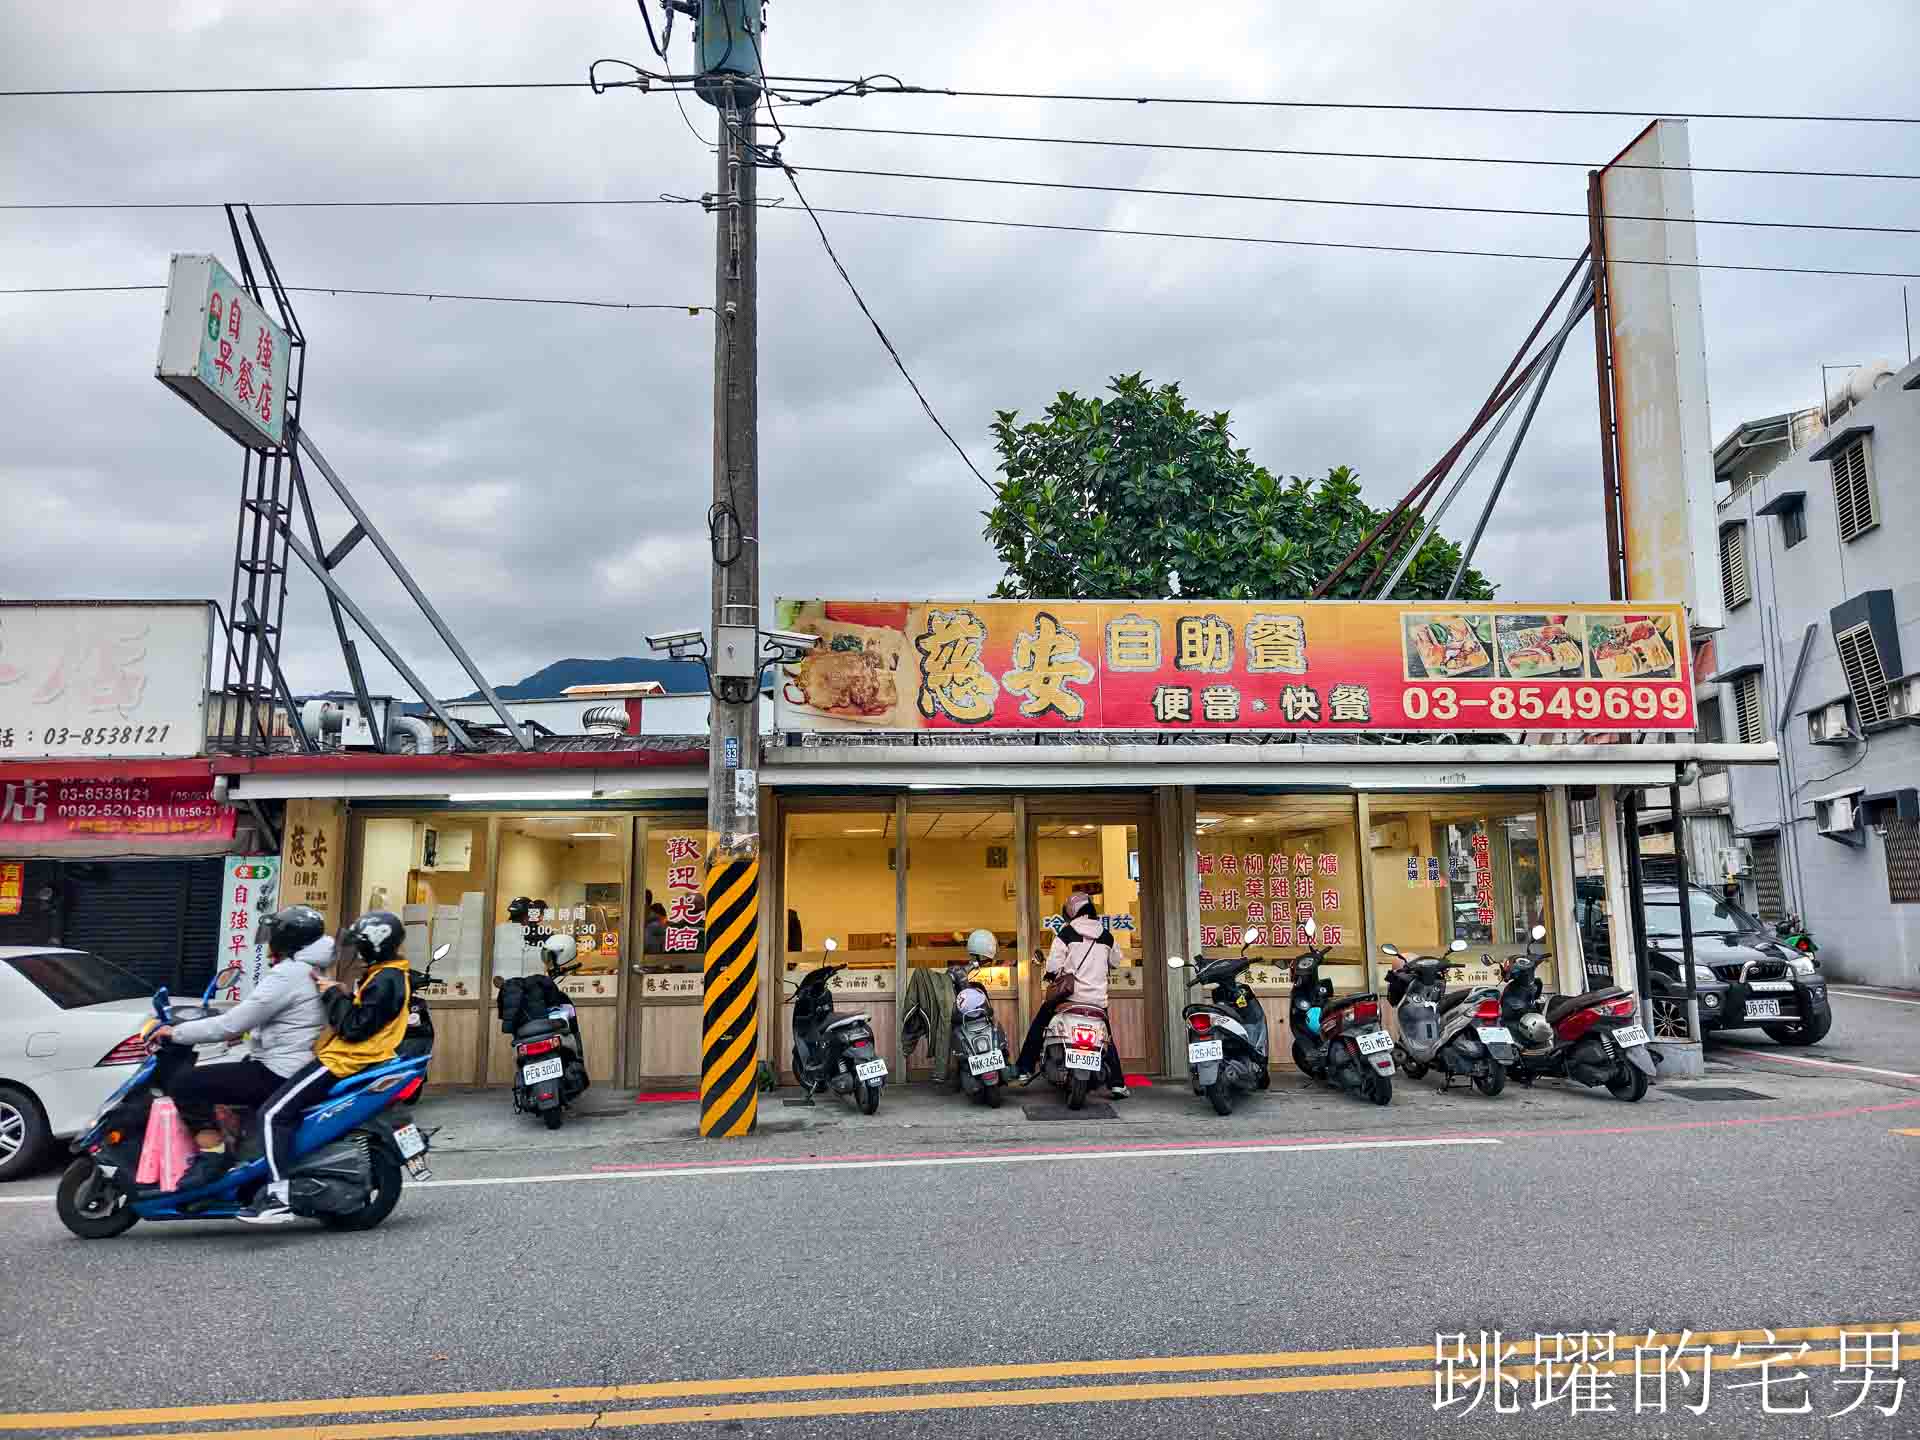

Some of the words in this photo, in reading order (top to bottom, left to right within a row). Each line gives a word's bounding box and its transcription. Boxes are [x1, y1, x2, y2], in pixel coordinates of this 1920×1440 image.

[915, 608, 1095, 725] 慈安
[1105, 613, 1307, 674] 自助餐
[44, 724, 171, 745] 03-8538121
[1401, 686, 1687, 720] 03-8549699
[664, 837, 706, 952] 歡迎光臨
[1269, 854, 1293, 945] 炸雞腿飯
